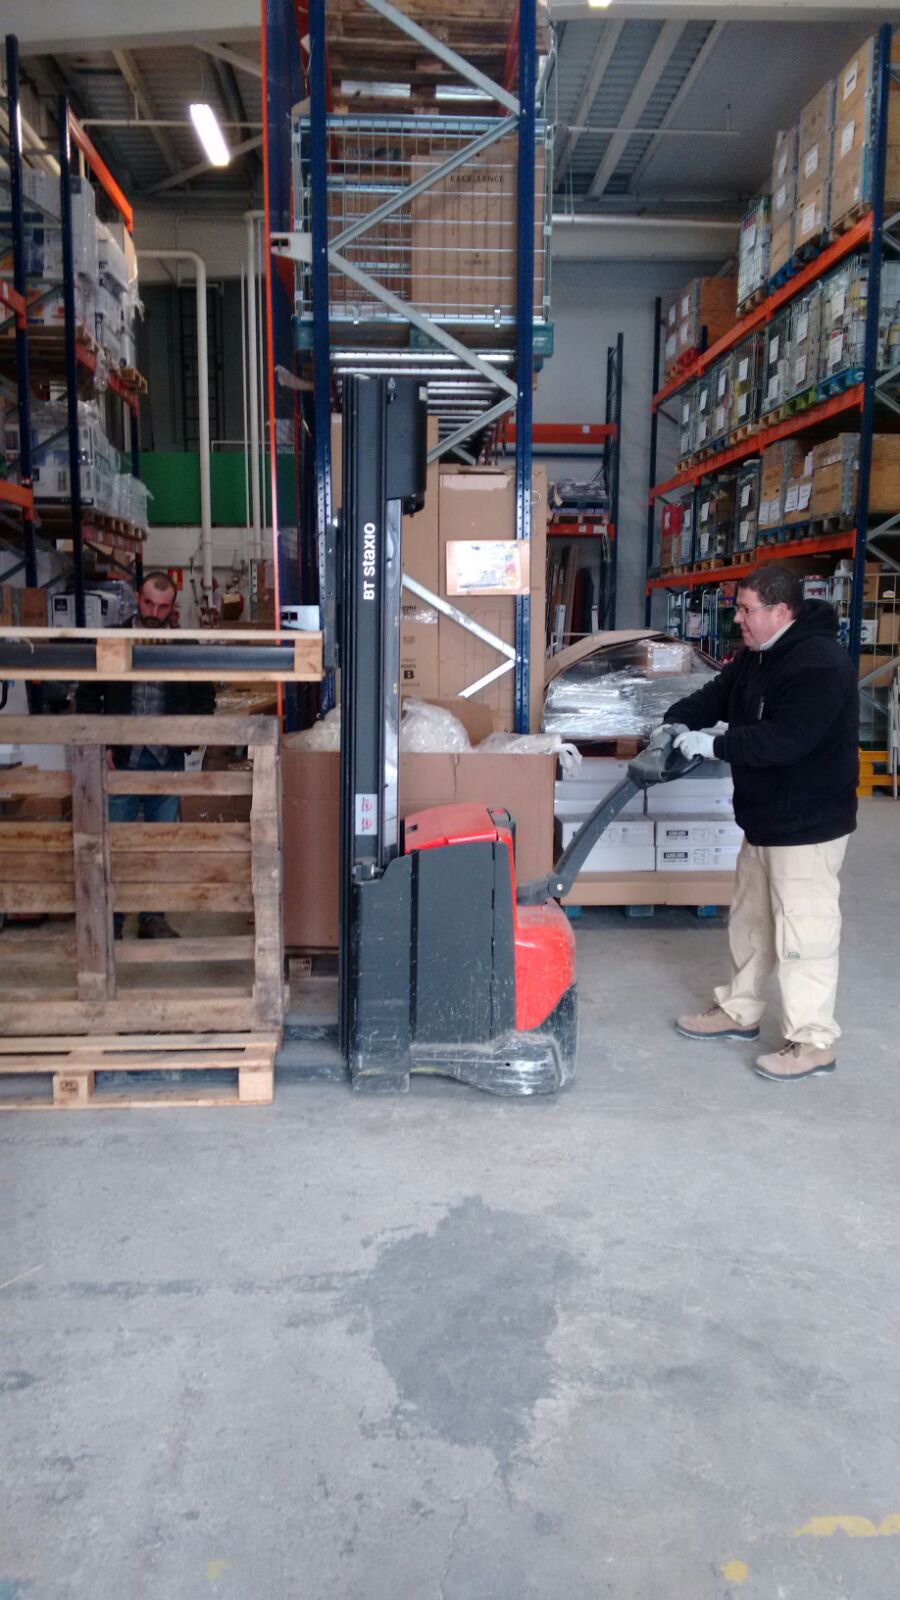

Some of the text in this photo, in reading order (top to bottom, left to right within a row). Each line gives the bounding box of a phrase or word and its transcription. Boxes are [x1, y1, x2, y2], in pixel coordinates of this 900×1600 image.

[450, 175, 504, 183] EXCELLENCE
[363, 580, 375, 600] BT
[404, 670, 415, 680] B
